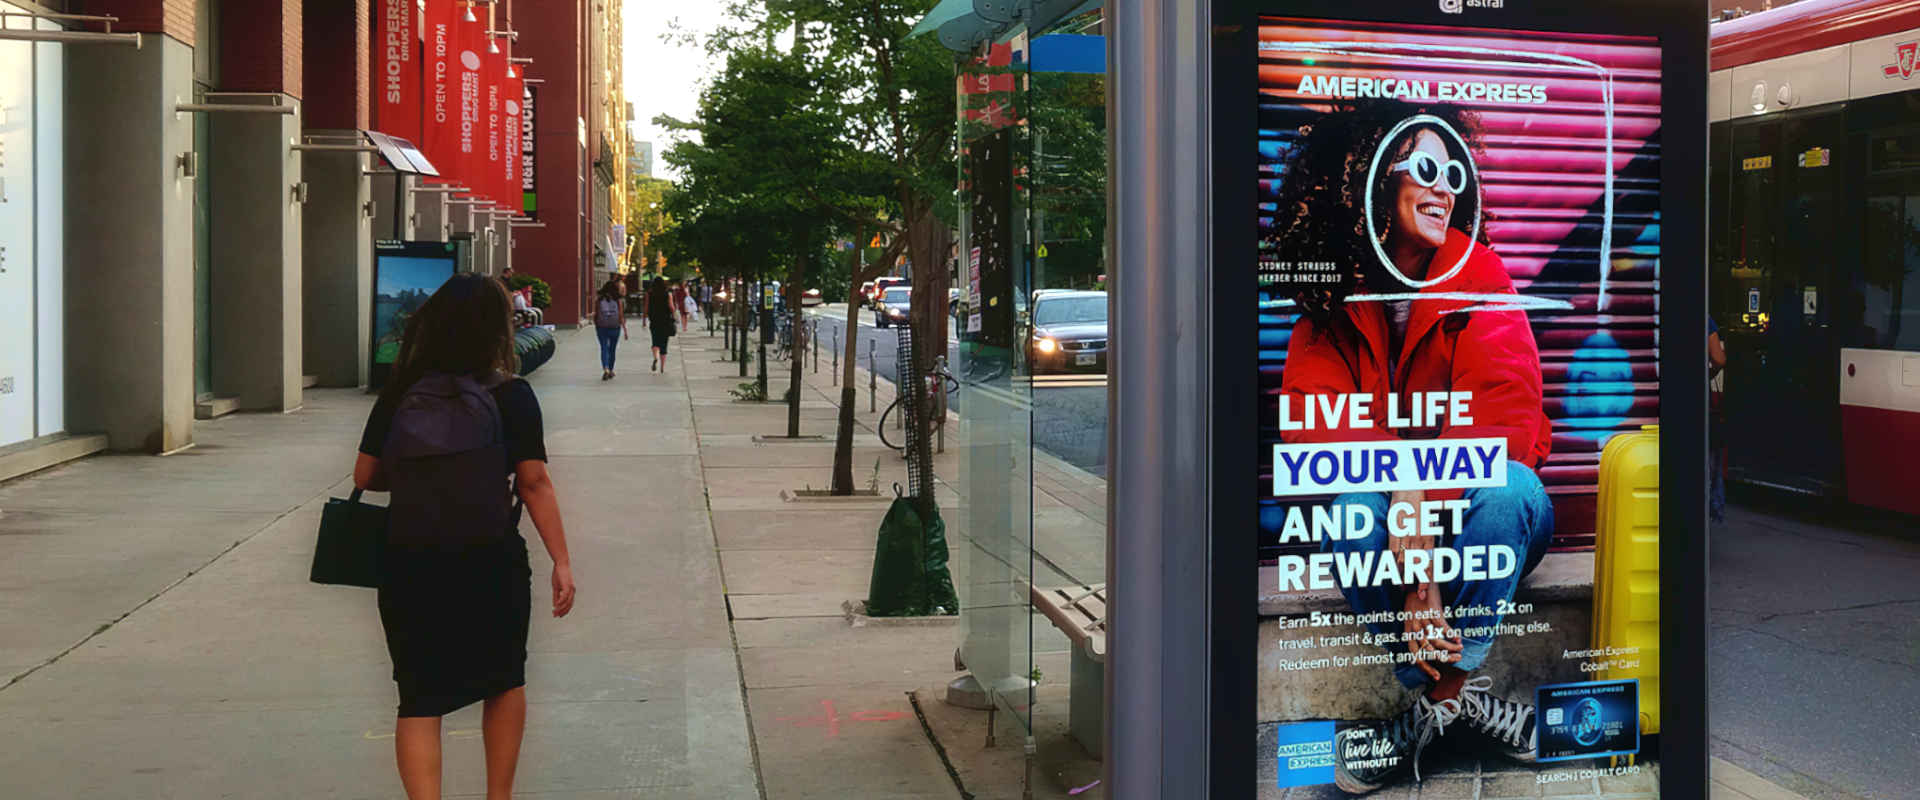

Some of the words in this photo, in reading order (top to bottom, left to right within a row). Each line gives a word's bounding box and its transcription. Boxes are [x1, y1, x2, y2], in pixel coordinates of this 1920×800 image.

[400, 28, 409, 61] DRUG
[436, 24, 446, 56] 10PM
[436, 61, 446, 80] TO
[436, 84, 446, 122] OPEN
[1297, 75, 1430, 99] AMERICAN
[1438, 82, 1547, 104] EXPRESS
[462, 72, 472, 153] SHOPPERS
[489, 114, 498, 129] TO
[522, 97, 534, 152] BLOCK
[489, 131, 498, 161] OPEN
[522, 155, 534, 190] H&R
[1293, 274, 1318, 283] SINCE
[1297, 261, 1337, 271] STRAUSS
[1279, 393, 1374, 430] LIVE
[1387, 391, 1473, 428] LIFE
[1280, 449, 1399, 486] YOUR
[1412, 445, 1501, 481] WAY
[1278, 504, 1375, 544] AND
[1387, 499, 1471, 538] GET
[1278, 544, 1517, 592] REWARDED
[1279, 616, 1308, 630] Earn
[1310, 611, 1332, 627] 5x
[1334, 612, 1354, 625] the
[1356, 609, 1395, 627] points
[1397, 610, 1413, 620] on
[1415, 608, 1441, 619] eats
[1443, 606, 1453, 618] &
[1496, 599, 1517, 615] 2x
[1518, 602, 1533, 614] on
[1320, 632, 1360, 647] transit
[1361, 632, 1373, 645] &
[1401, 629, 1424, 642] and
[1426, 623, 1445, 640] 1x
[1446, 627, 1462, 638] on
[1463, 621, 1525, 638] everything
[1527, 621, 1553, 633] else.
[1279, 658, 1330, 671] Redeem
[1333, 655, 1350, 669] for
[1352, 651, 1394, 666] almost
[1396, 648, 1451, 665] anything.
[1562, 648, 1604, 659] American
[1279, 742, 1331, 755] AMERICAN
[1345, 742, 1371, 759] live
[1371, 738, 1395, 757] life
[1346, 729, 1375, 740] DON'T
[1346, 758, 1387, 770] WITHOUT
[1535, 771, 1573, 784] SEARCH
[1579, 767, 1614, 779] COBALT
[1615, 765, 1640, 776] CARD
